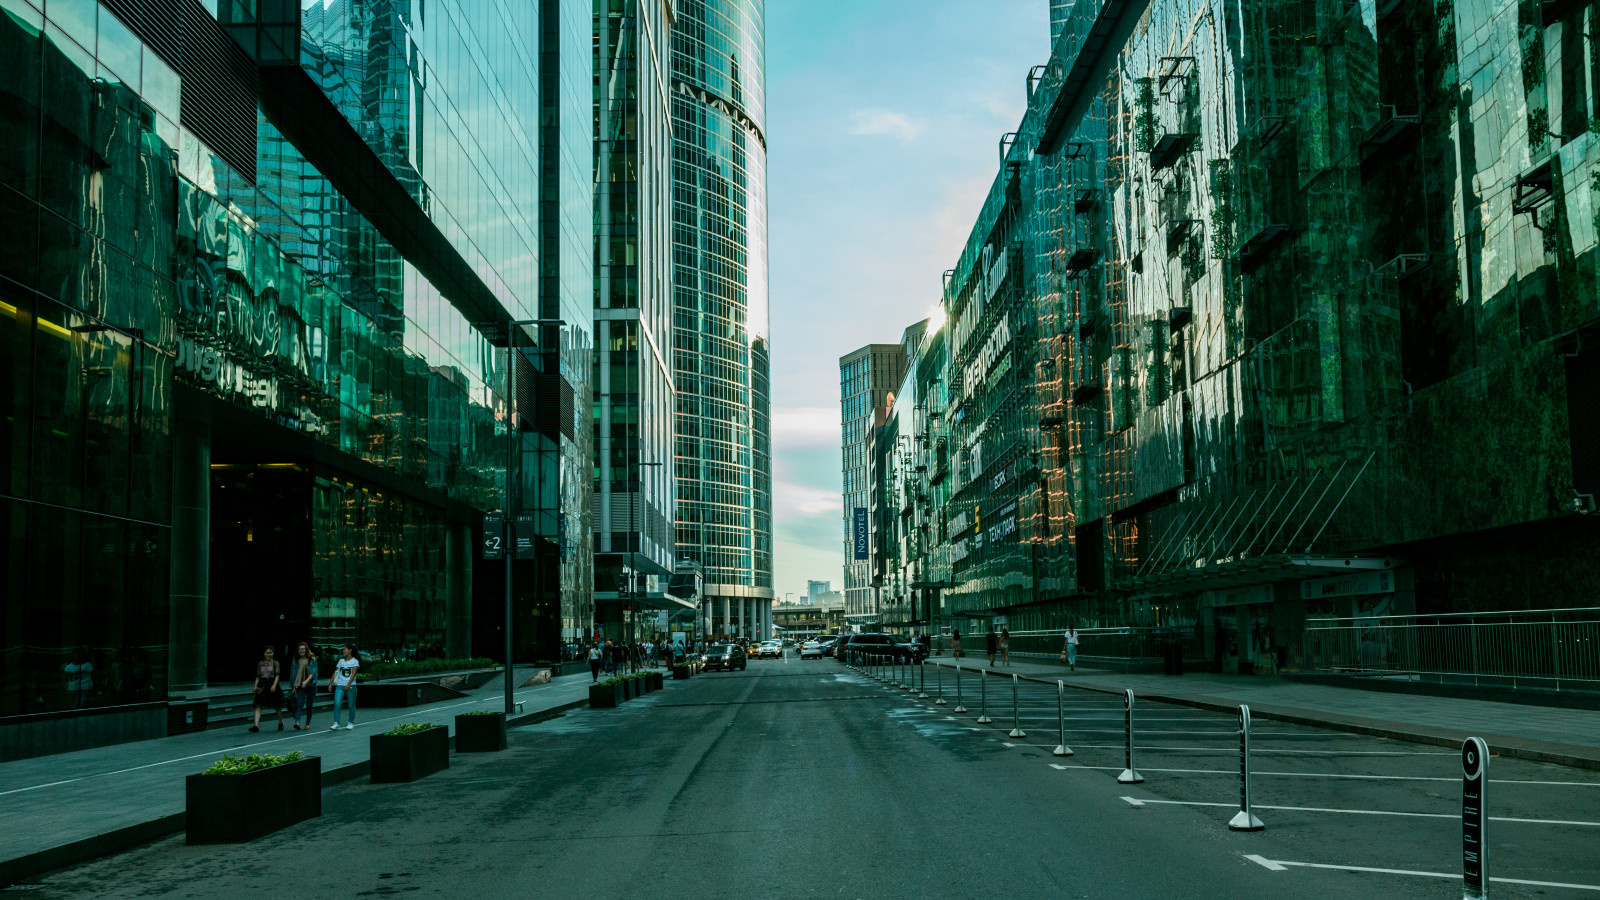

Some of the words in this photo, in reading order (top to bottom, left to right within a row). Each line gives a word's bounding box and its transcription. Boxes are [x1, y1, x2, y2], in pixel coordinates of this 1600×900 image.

[492, 536, 500, 550] 2
[857, 510, 866, 553] NOVOTEL
[1464, 791, 1478, 877] EMPIRE
